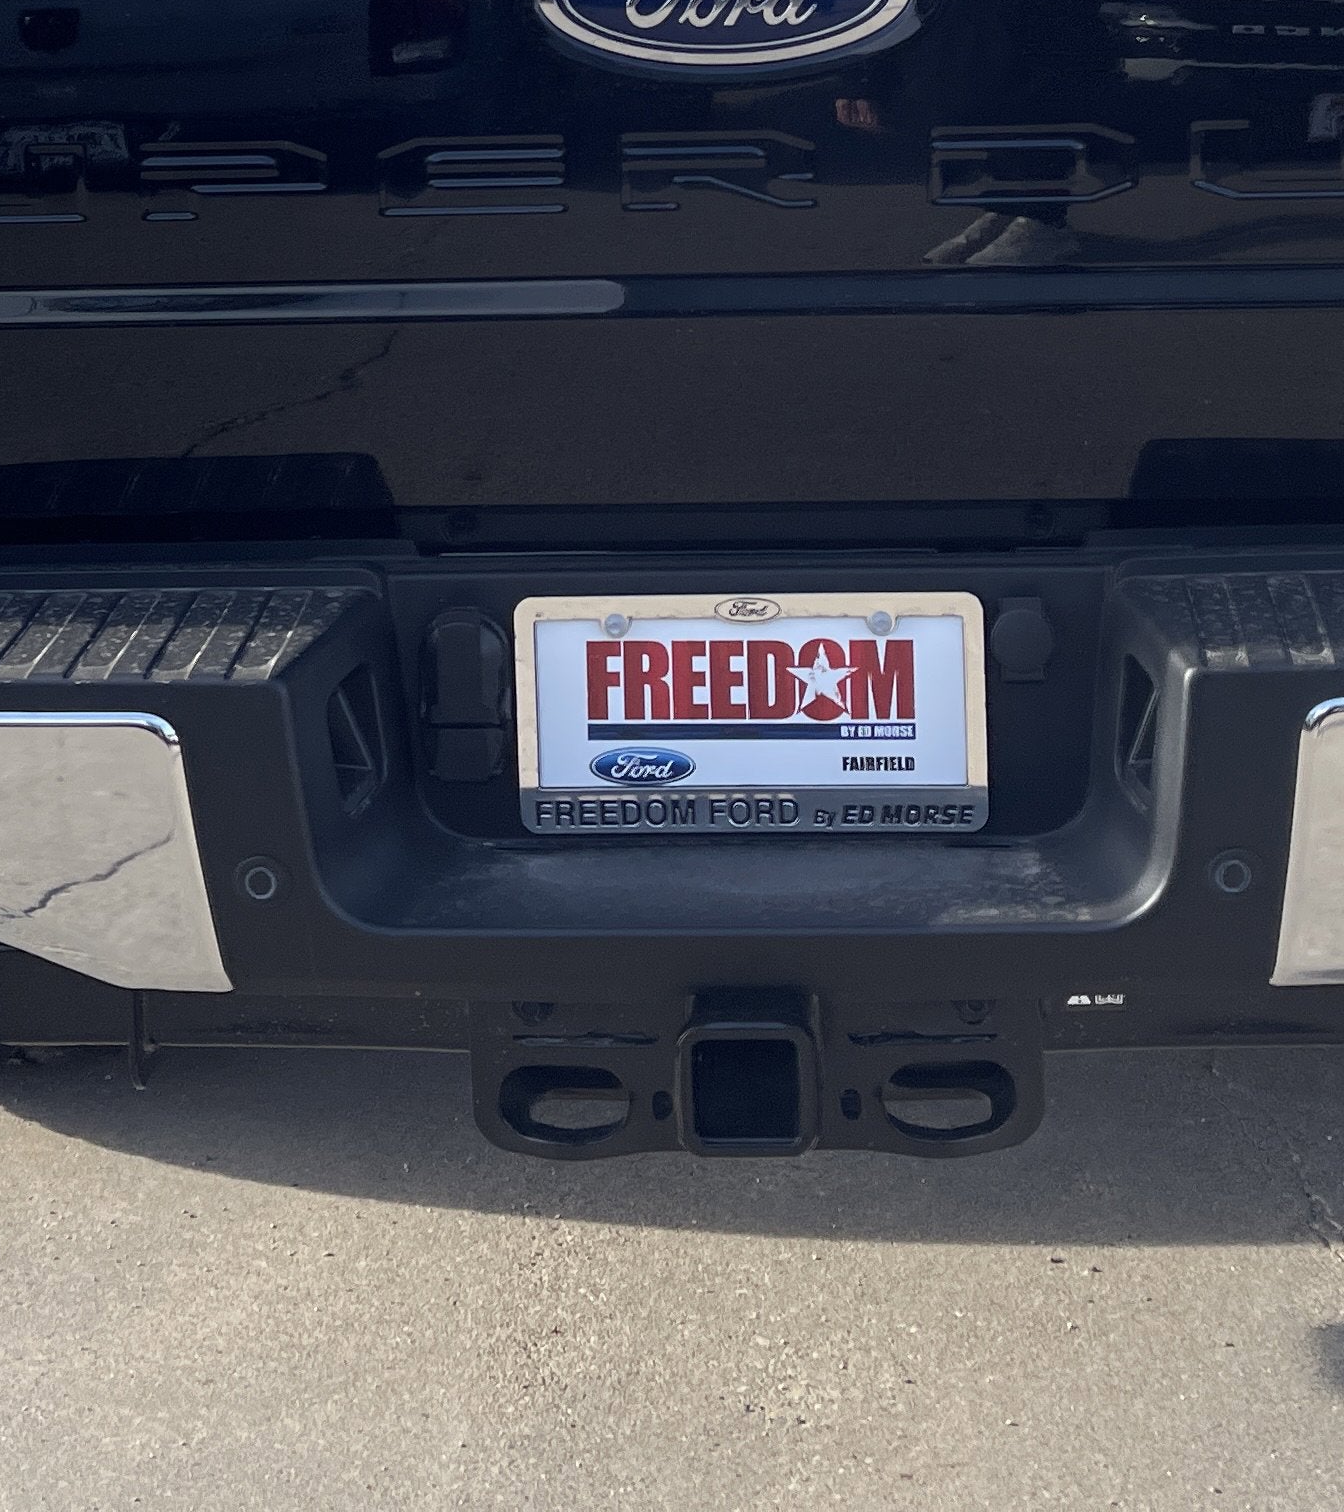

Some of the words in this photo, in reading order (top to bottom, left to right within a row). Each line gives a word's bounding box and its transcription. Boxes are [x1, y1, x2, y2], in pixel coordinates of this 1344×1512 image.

[728, 600, 767, 619] Ford
[586, 638, 916, 721] FREEDOM
[840, 725, 856, 738] BY
[857, 725, 872, 738] ED
[873, 725, 915, 738] MORSE
[611, 753, 673, 779] Ford
[842, 756, 916, 772] FAIRFIELD
[534, 795, 698, 829] FREEDOM
[708, 794, 800, 829] FORD
[812, 809, 836, 830] By
[840, 805, 875, 826] ED
[879, 805, 977, 827] MORSE
